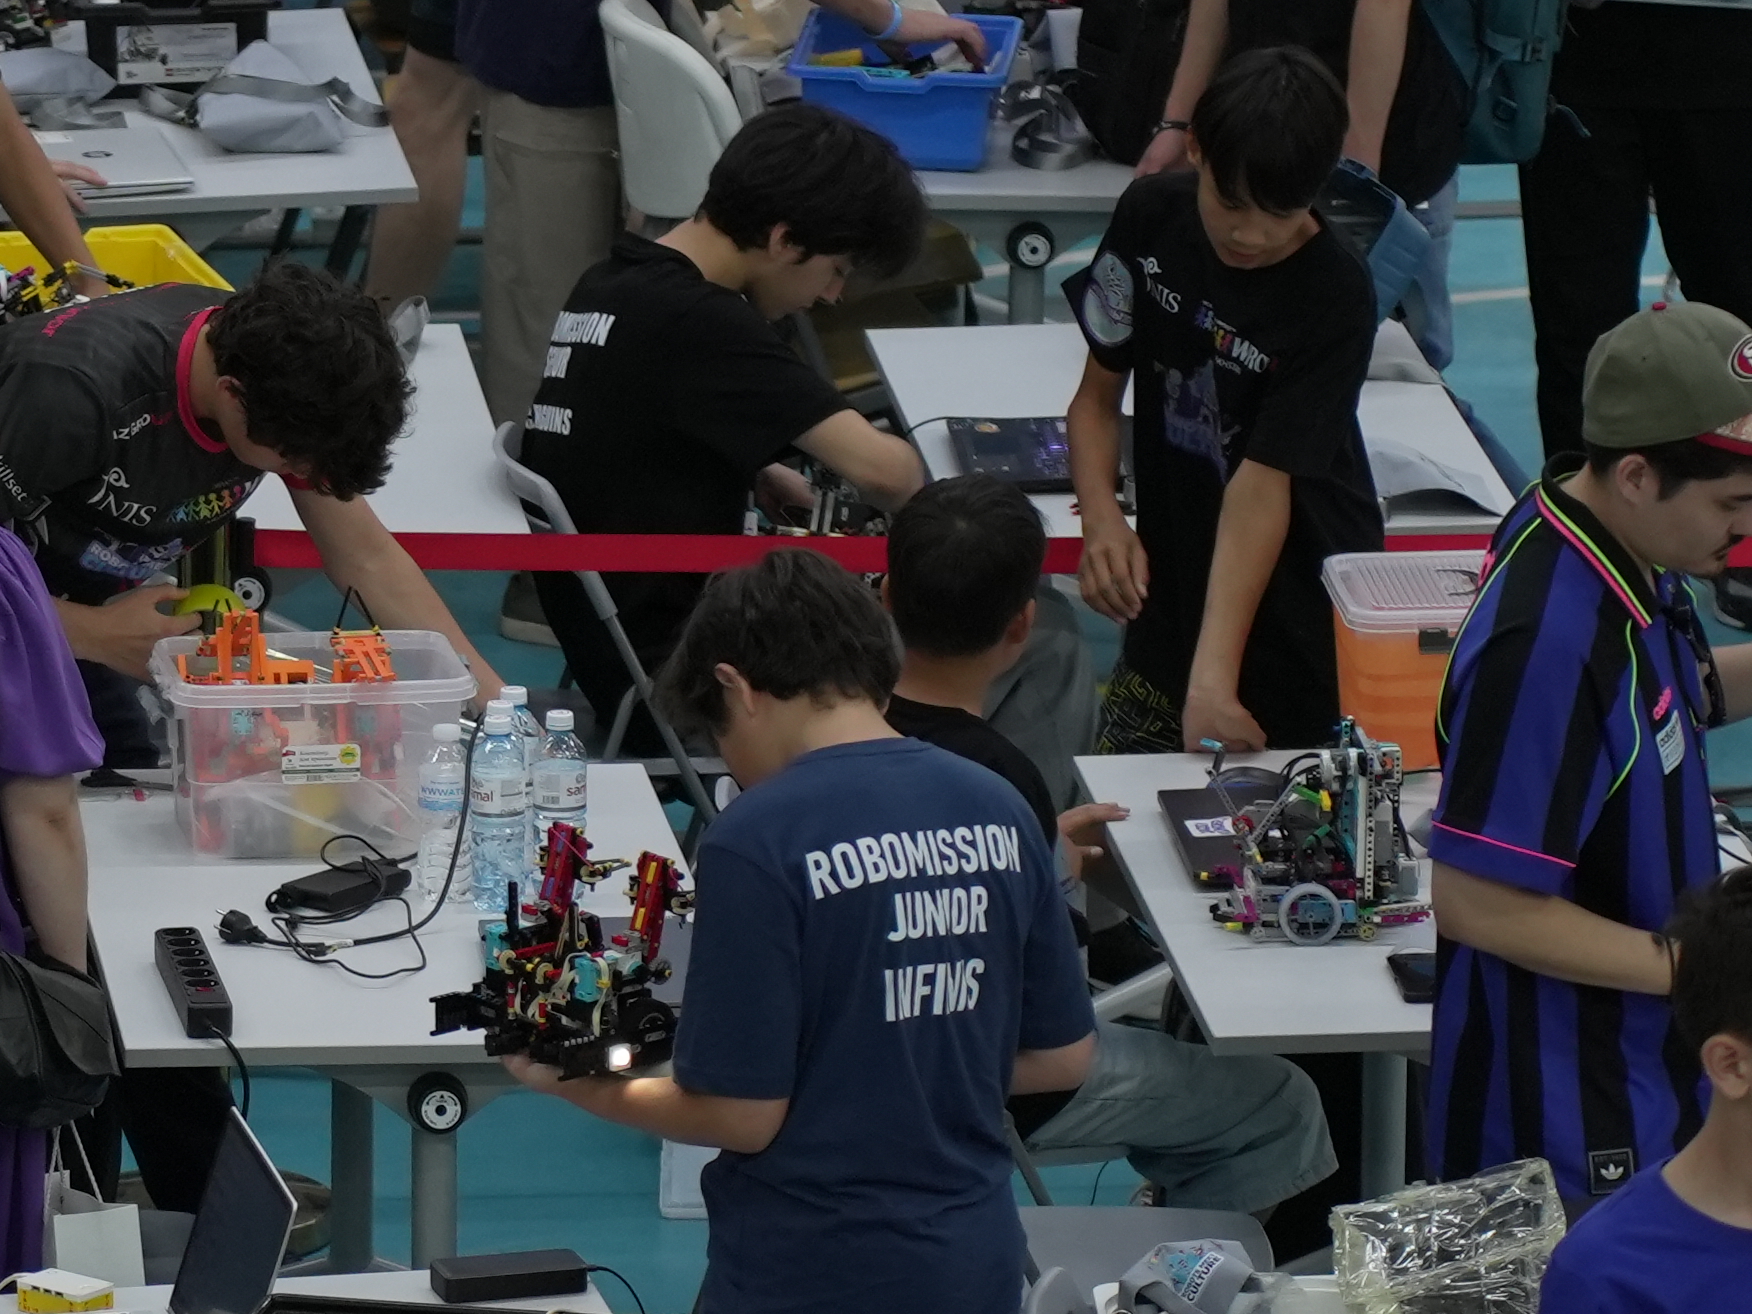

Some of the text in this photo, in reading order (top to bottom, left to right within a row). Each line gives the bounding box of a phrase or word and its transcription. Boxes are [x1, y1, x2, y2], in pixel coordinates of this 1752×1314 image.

[104, 490, 157, 528] NIS
[805, 822, 1023, 900] ROBOMISSION
[887, 885, 990, 943] JUNIOR
[1186, 1256, 1222, 1303] CULTURE
